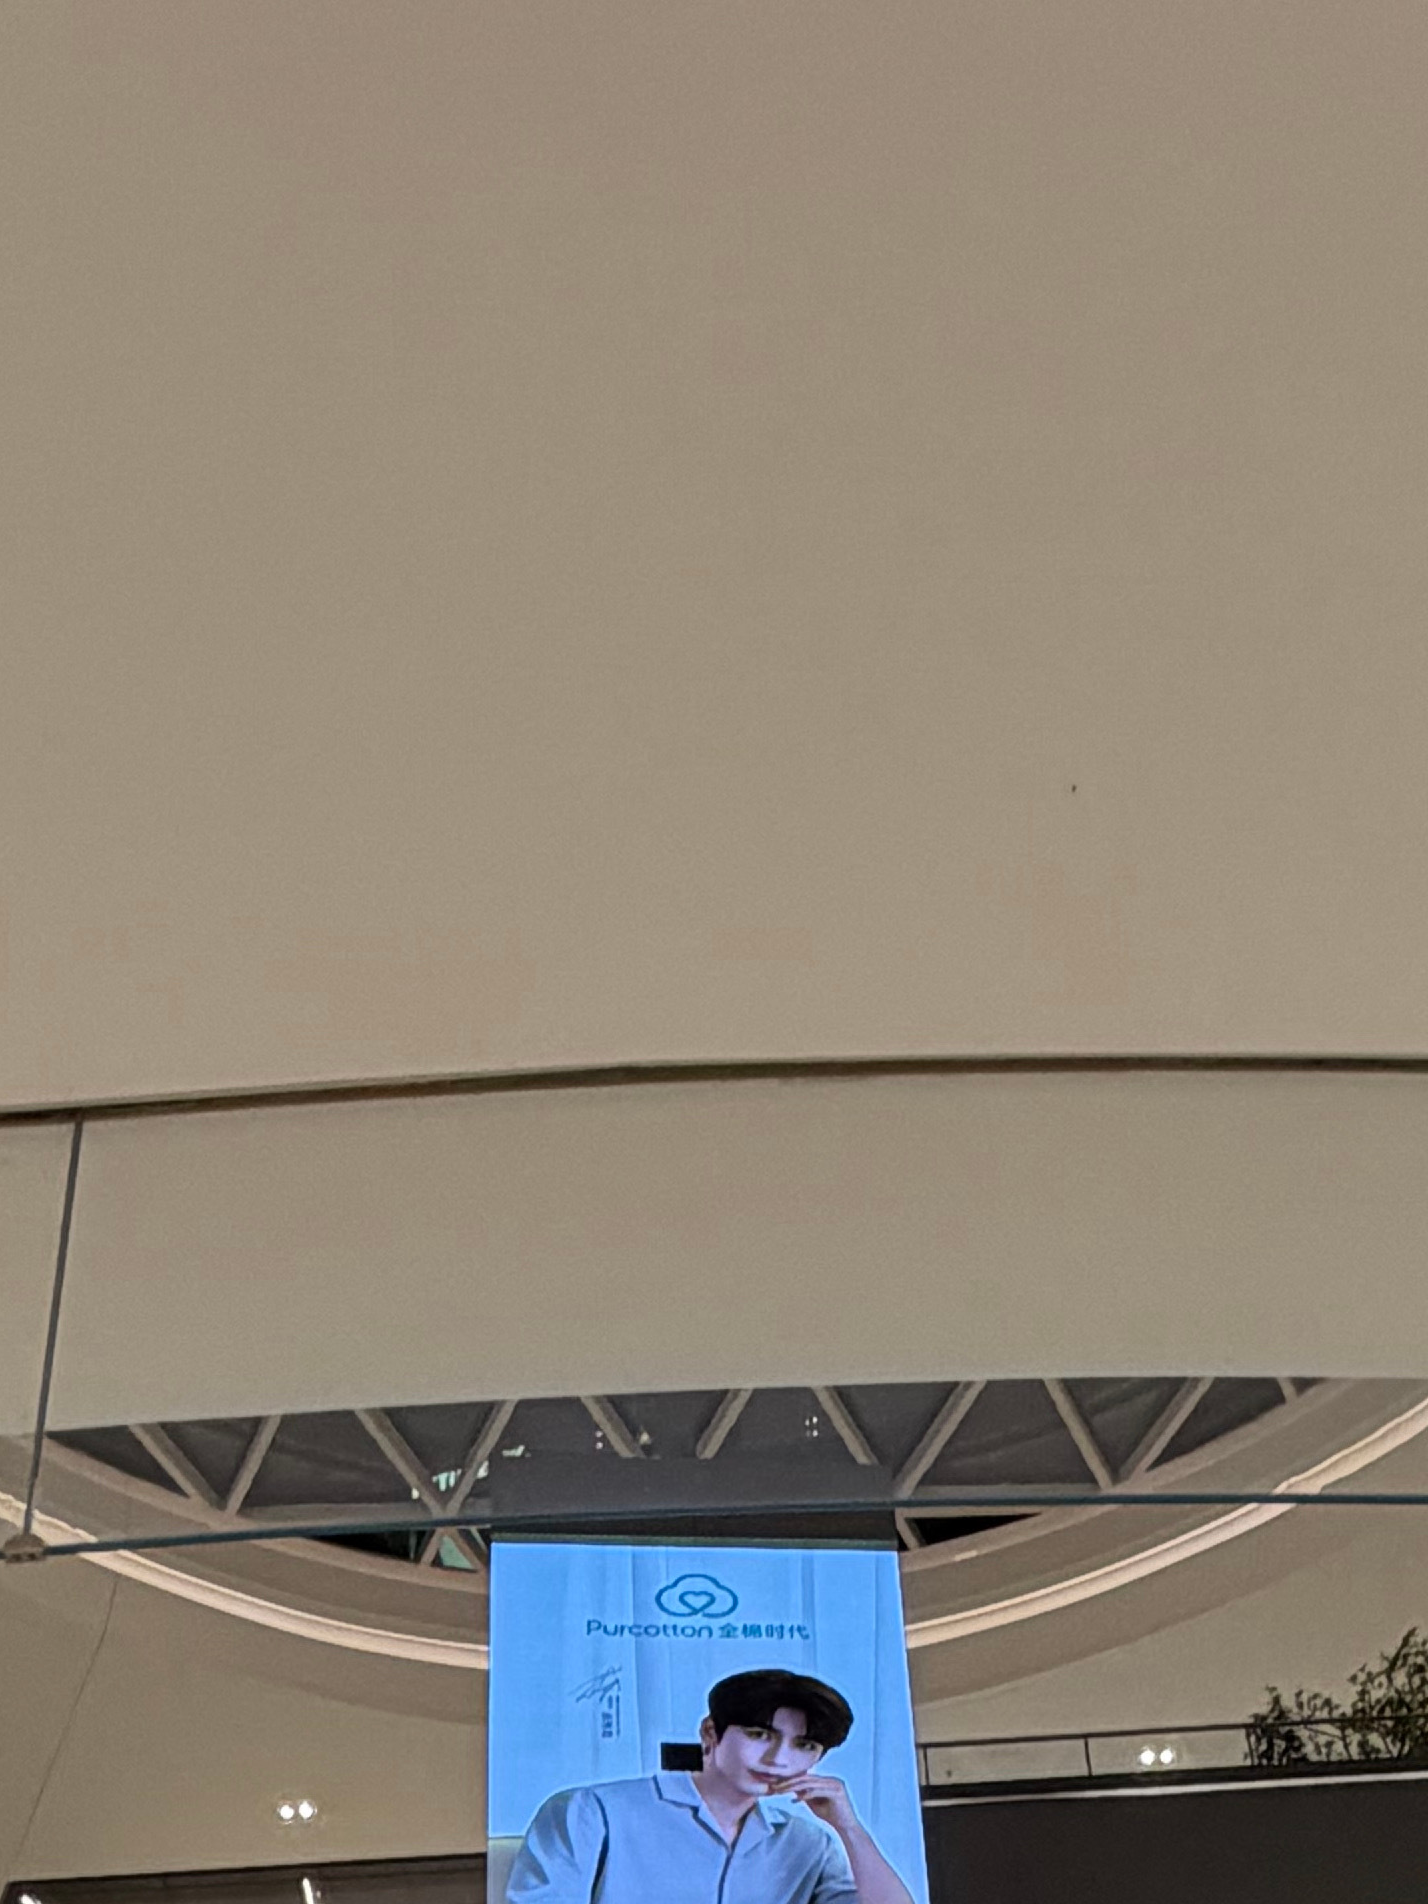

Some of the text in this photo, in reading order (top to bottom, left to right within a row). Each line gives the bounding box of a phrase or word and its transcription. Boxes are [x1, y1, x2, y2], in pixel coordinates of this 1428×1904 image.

[586, 1619, 811, 1639] Purcotton 全棉时代
